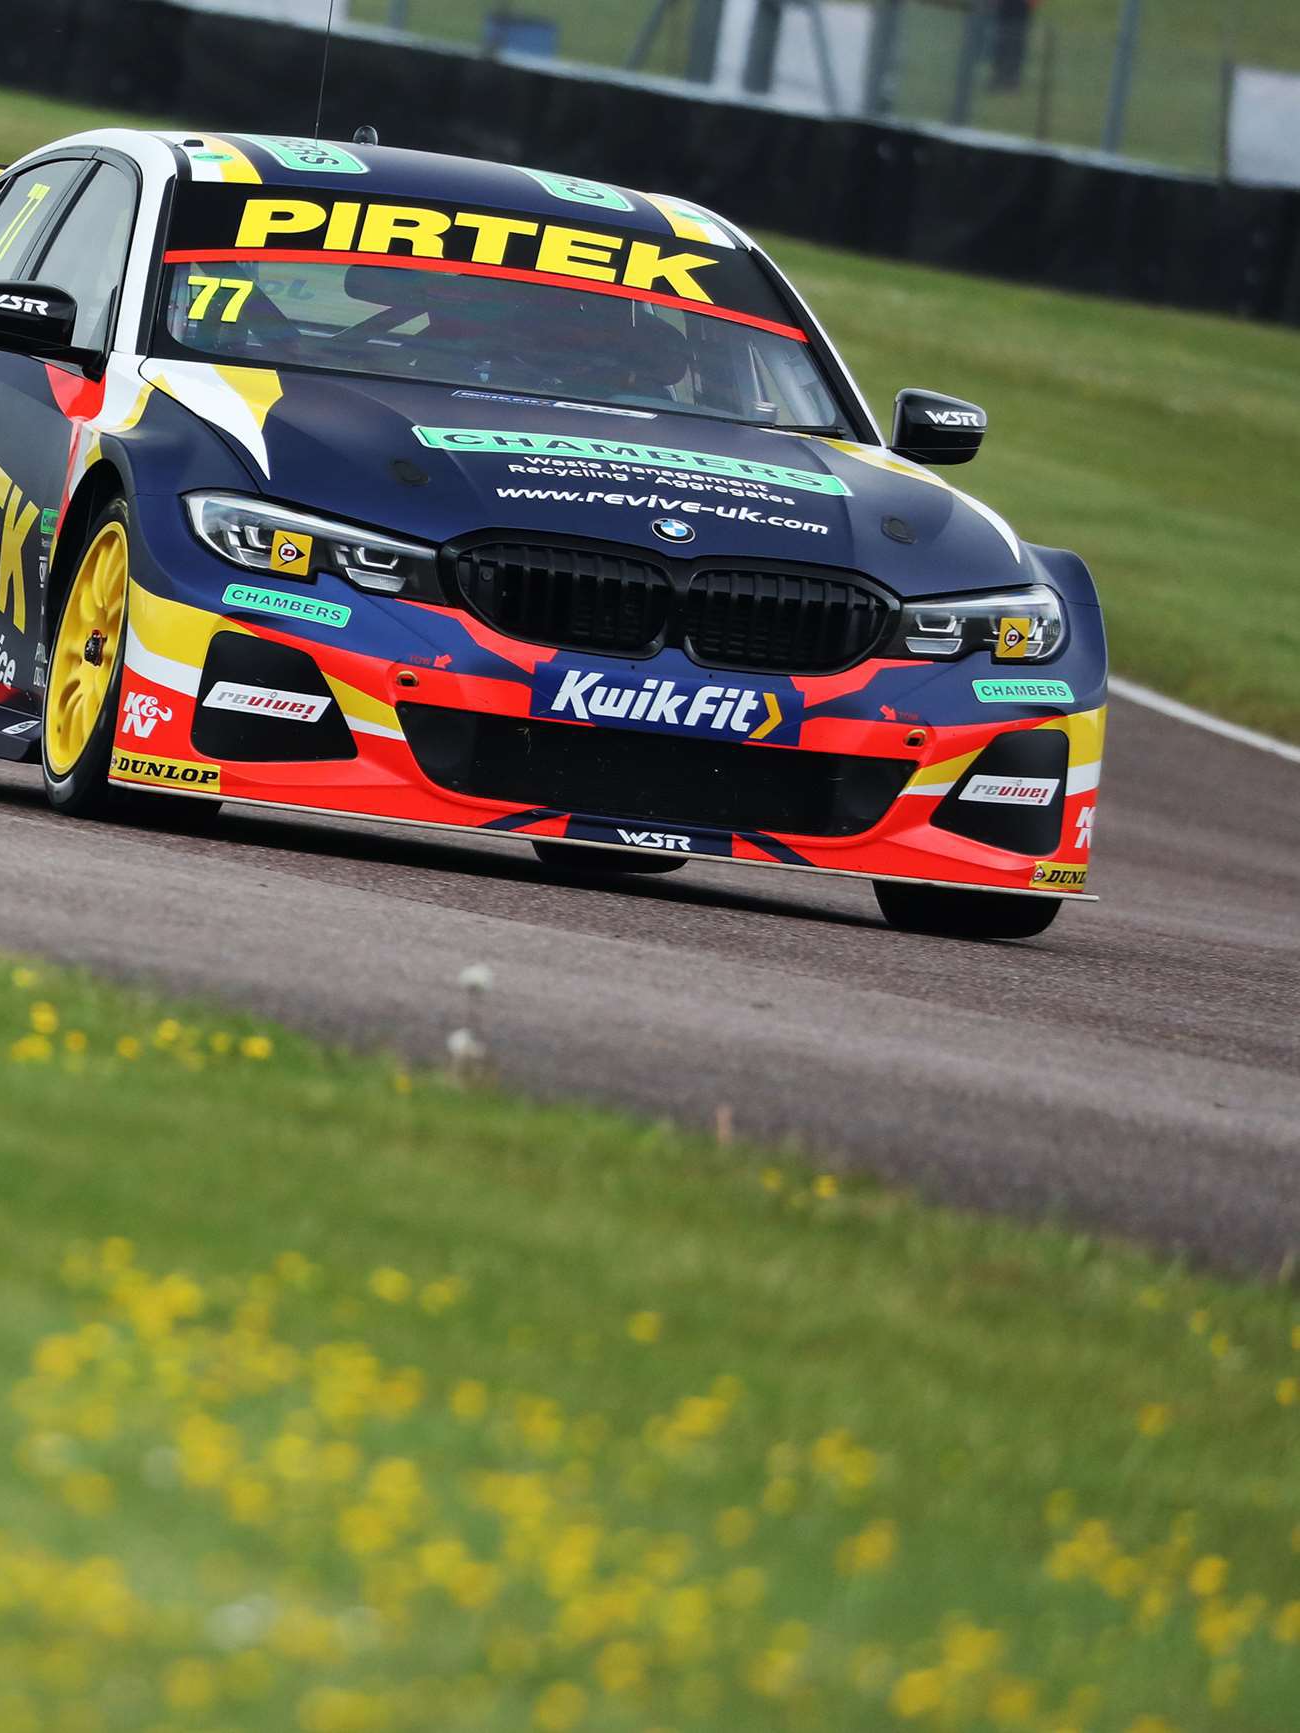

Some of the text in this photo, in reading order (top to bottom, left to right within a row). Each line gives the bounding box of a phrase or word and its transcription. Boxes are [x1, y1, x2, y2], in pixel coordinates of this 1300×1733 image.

[234, 199, 720, 305] PIRTEK
[187, 275, 254, 323] 77
[924, 410, 979, 427] WSR
[443, 433, 823, 487] CHAMBERS
[524, 456, 769, 492] Waste Management
[508, 464, 630, 482] Recycling
[655, 476, 796, 506] Aggregates
[496, 488, 829, 535] www.revive-uk.com
[232, 589, 342, 622] CHAMBERS
[218, 689, 316, 720] revive!
[981, 685, 1067, 697] CHAMBERS
[118, 757, 219, 784] DUNLOP
[972, 784, 1049, 804] revive!
[616, 828, 691, 851] WSR
